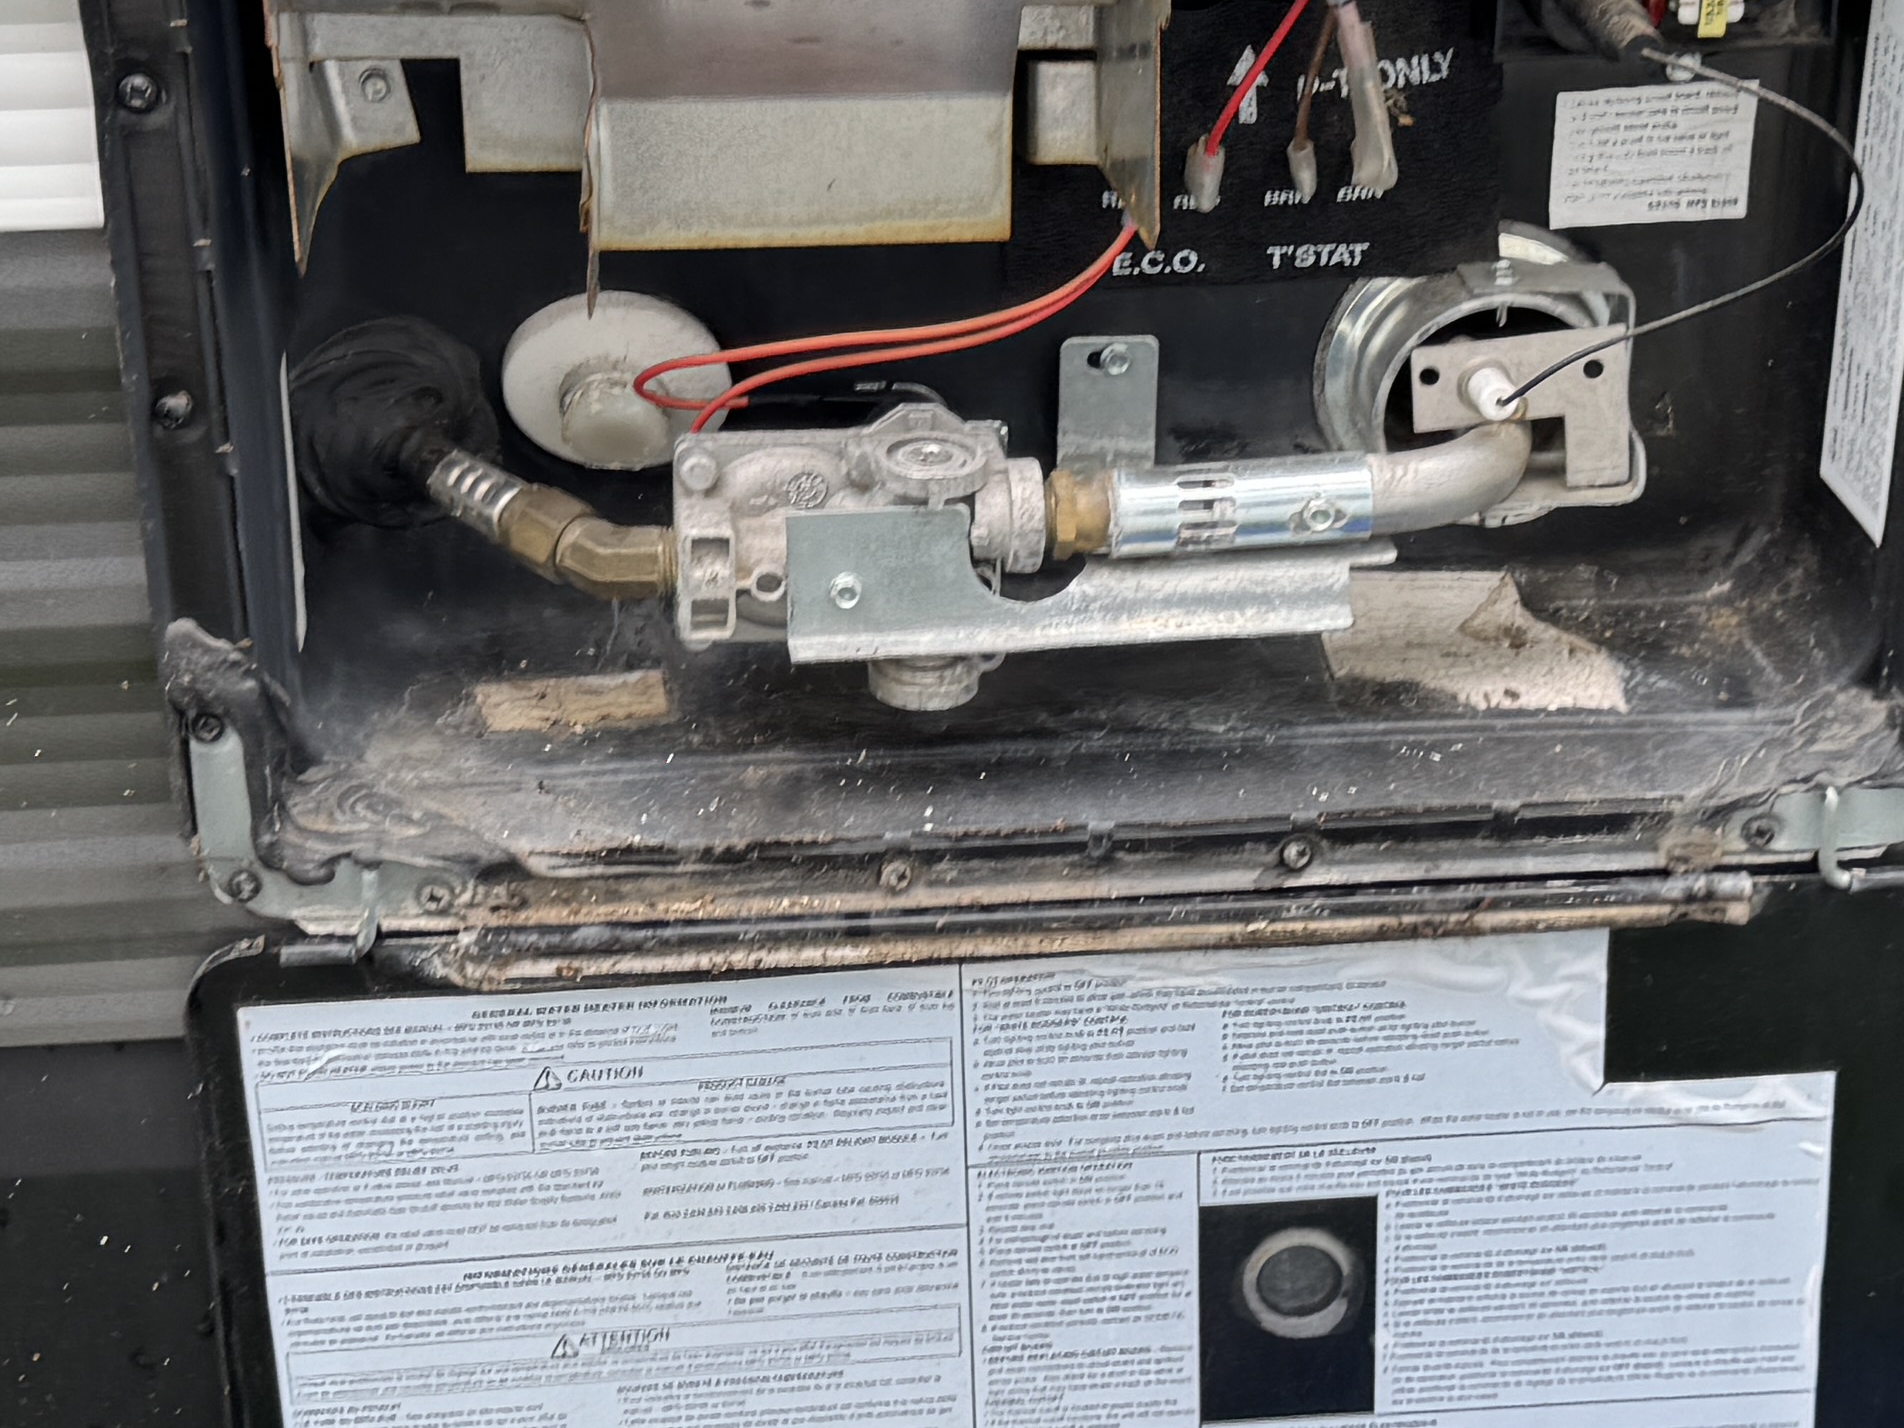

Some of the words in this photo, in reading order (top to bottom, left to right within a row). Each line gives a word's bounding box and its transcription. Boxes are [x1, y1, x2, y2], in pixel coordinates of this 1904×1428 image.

[1377, 47, 1454, 89] ONLY
[1112, 248, 1205, 277] E.C.O.
[1266, 242, 1371, 270] T'STAT
[566, 1065, 644, 1084] CAUTION
[579, 1327, 671, 1347] ATTENTION
